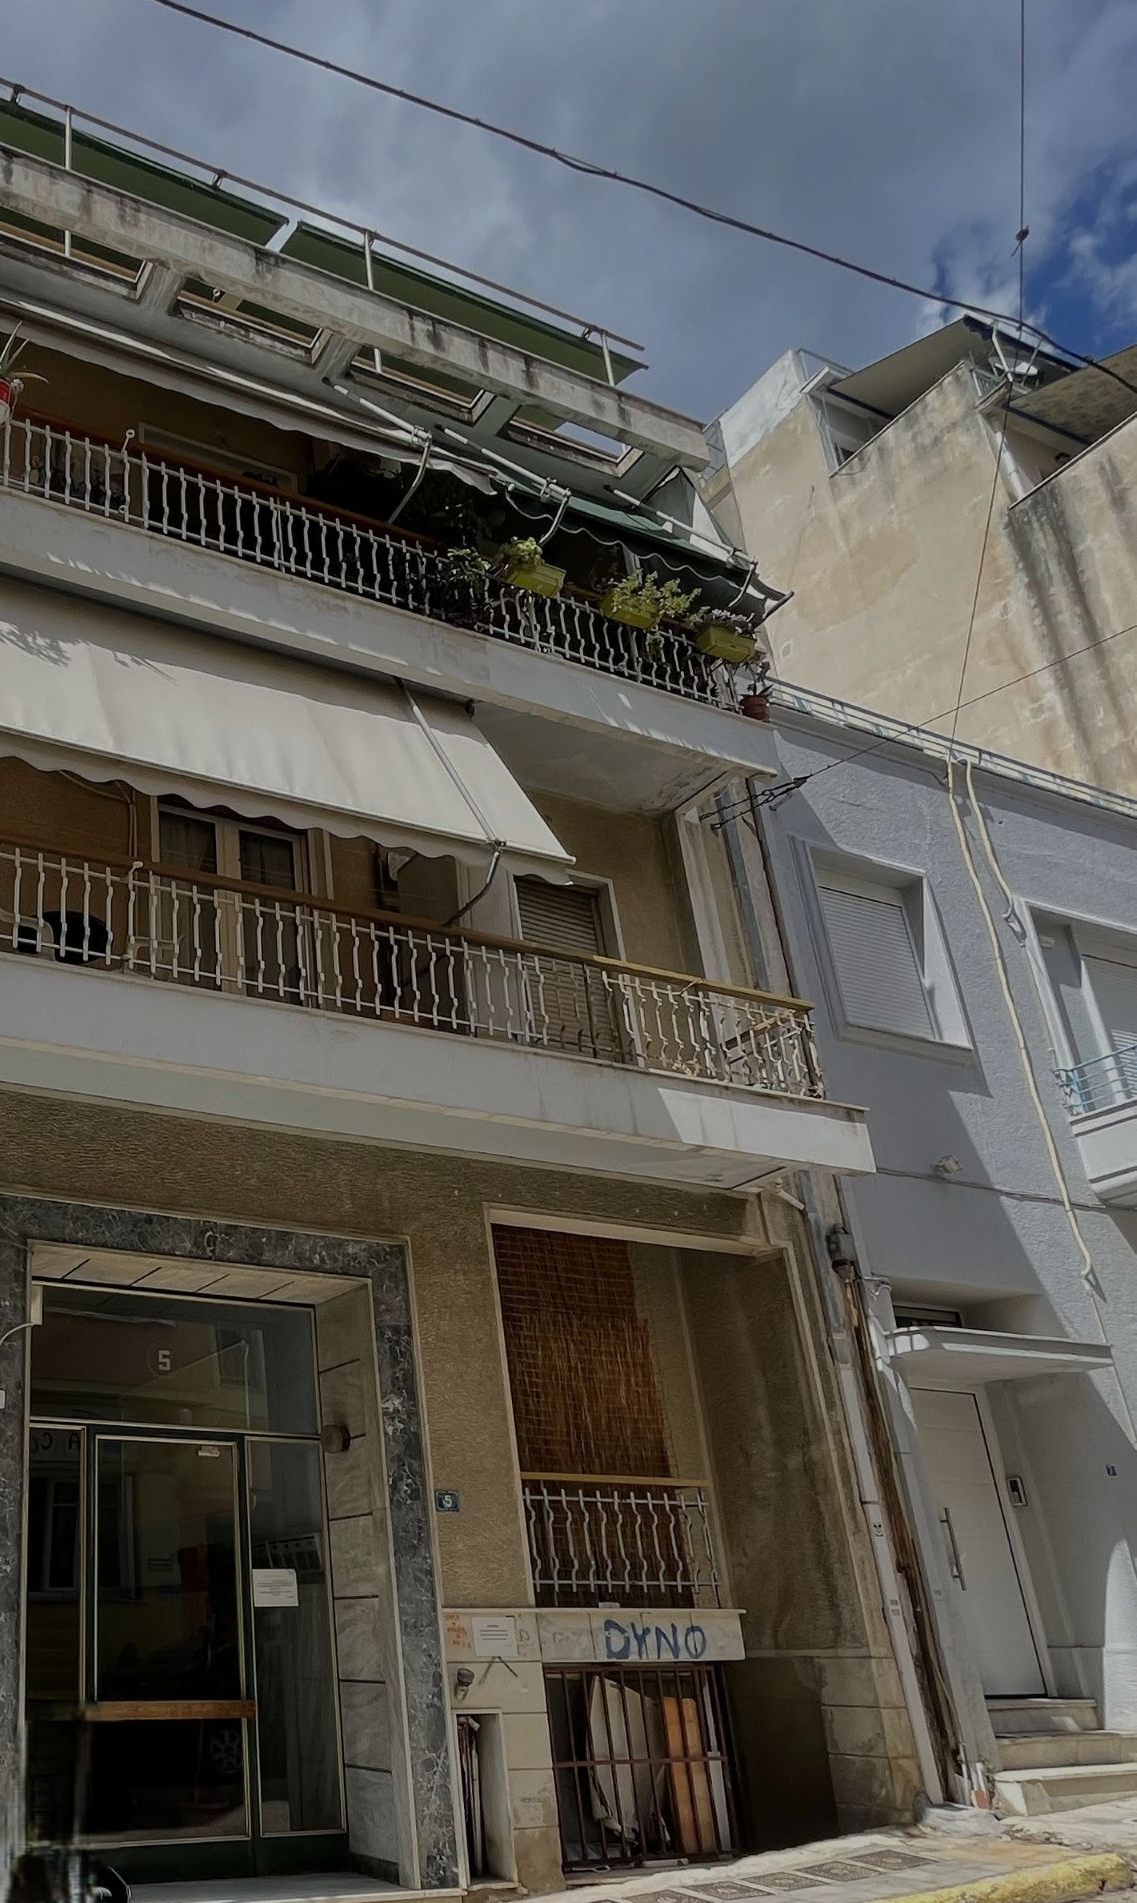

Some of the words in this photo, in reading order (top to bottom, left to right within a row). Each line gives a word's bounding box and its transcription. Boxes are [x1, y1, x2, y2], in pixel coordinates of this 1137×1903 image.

[158, 1349, 171, 1371] 5
[442, 1494, 453, 1508] 5
[604, 1618, 707, 1659] DYNO
